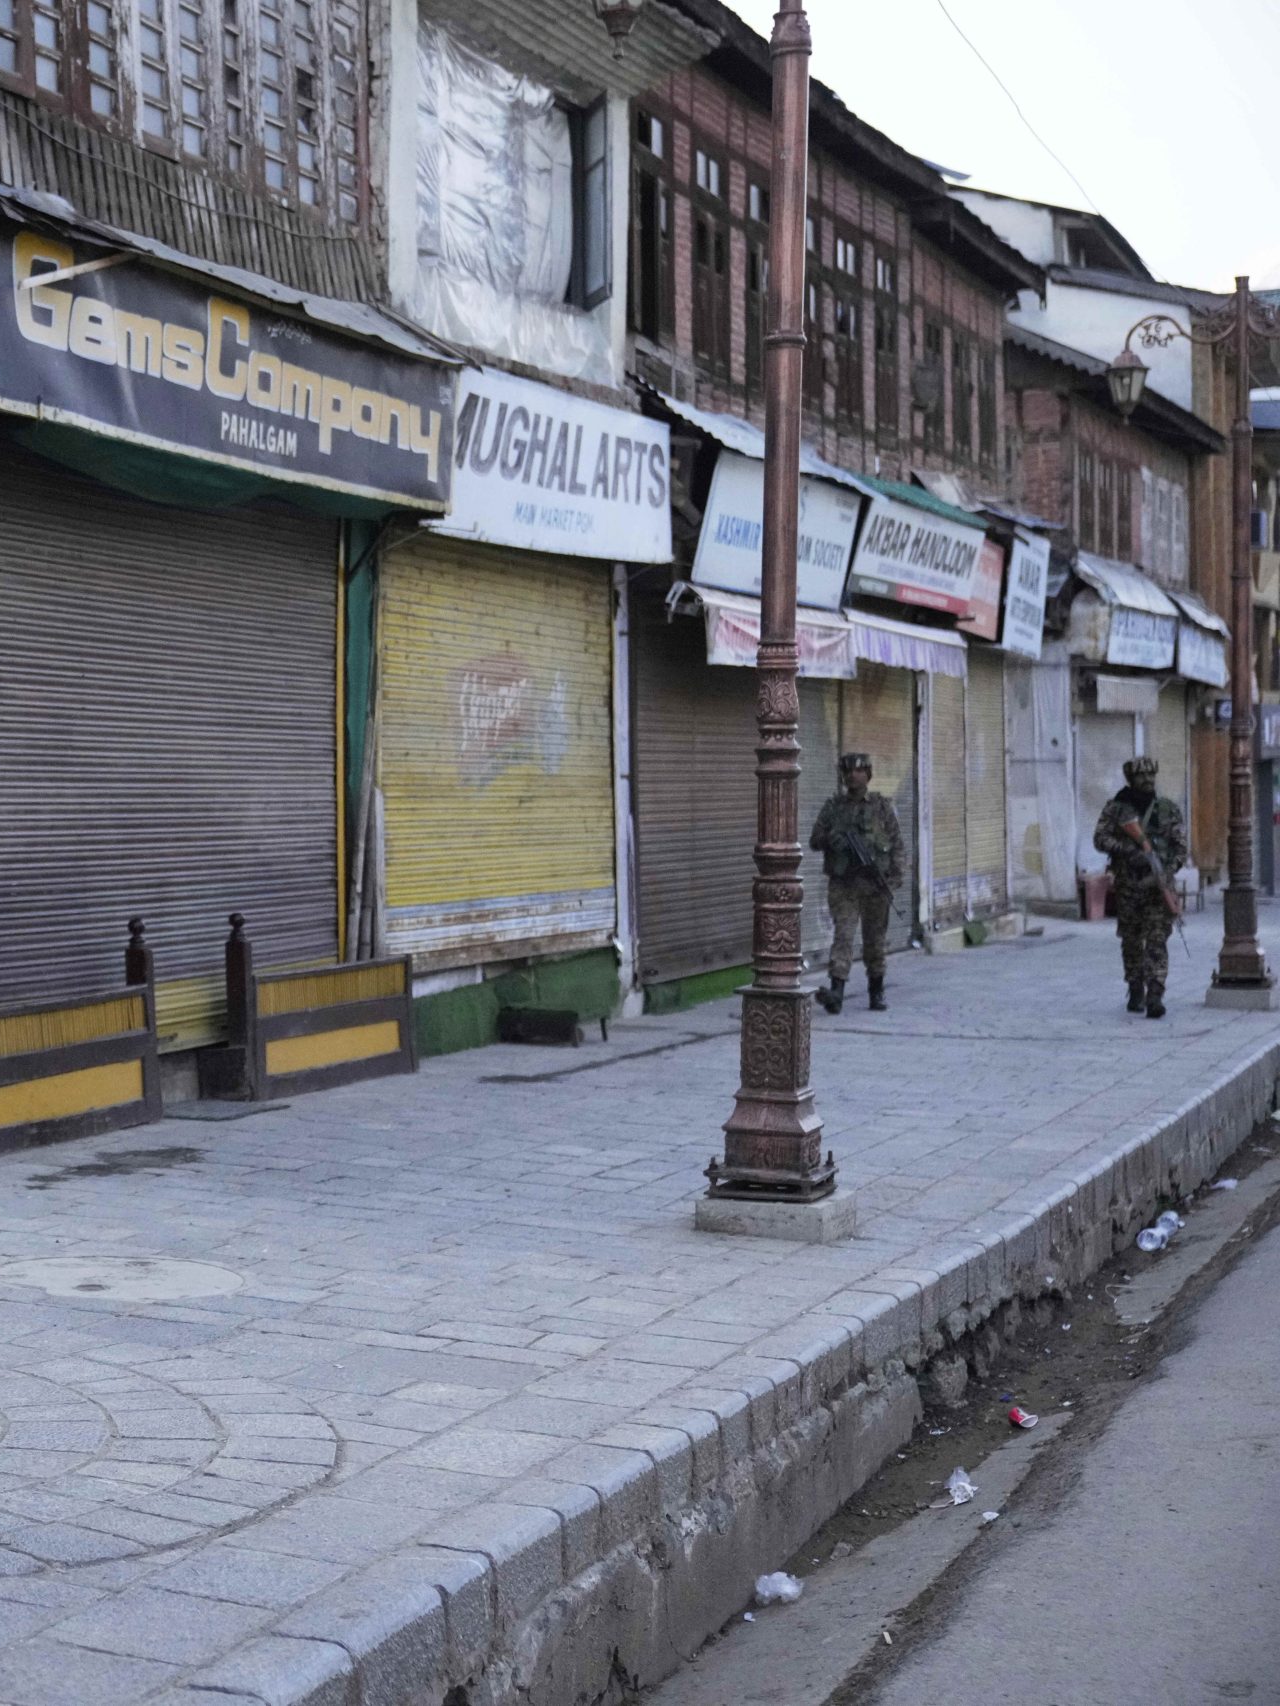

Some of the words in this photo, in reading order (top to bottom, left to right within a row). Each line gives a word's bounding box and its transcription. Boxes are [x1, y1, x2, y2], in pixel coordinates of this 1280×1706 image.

[221, 411, 298, 457] PAHALGAM
[590, 431, 666, 509] ARTS
[863, 515, 912, 561] AKBAR
[907, 527, 979, 580] HANDLOOM
